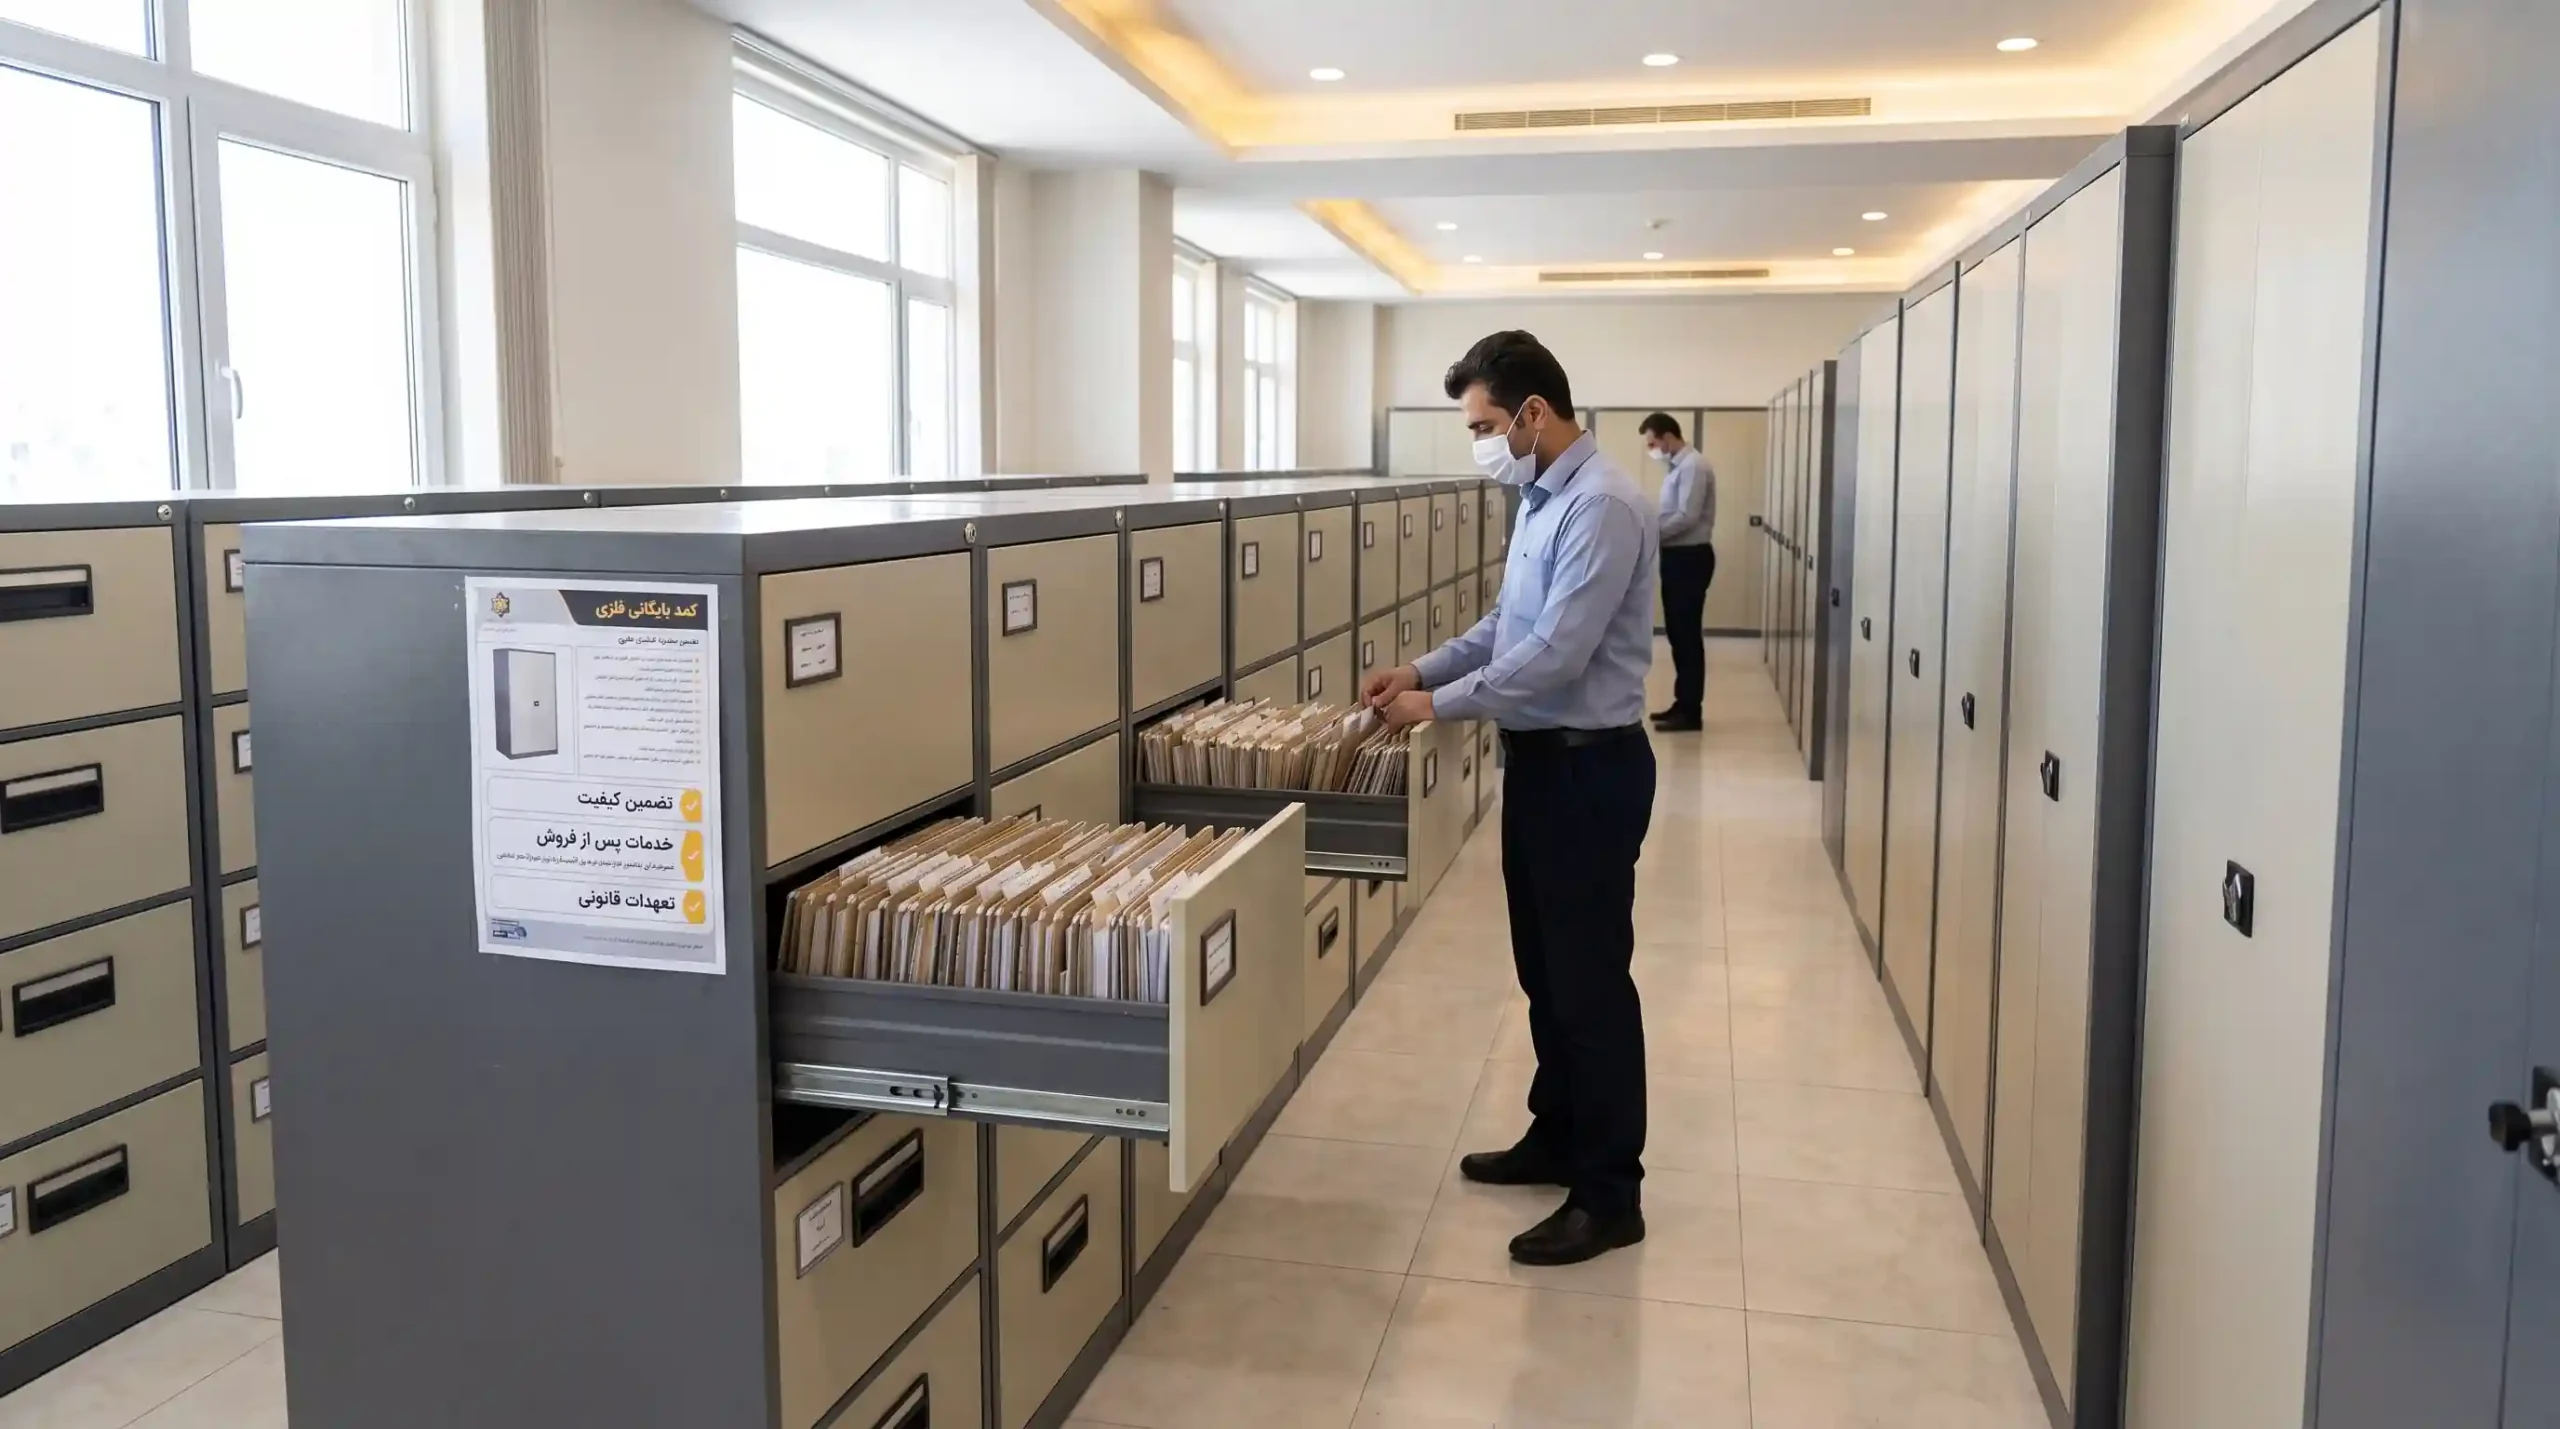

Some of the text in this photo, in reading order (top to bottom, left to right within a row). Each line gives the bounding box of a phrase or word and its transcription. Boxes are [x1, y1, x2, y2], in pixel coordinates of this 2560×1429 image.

[595, 599, 699, 620] کمد بایگانی فلزی
[577, 791, 673, 812] تضمین کیفیت
[536, 829, 673, 853] خدمات پس از فروش
[578, 890, 675, 913] تعهدات قانونی
